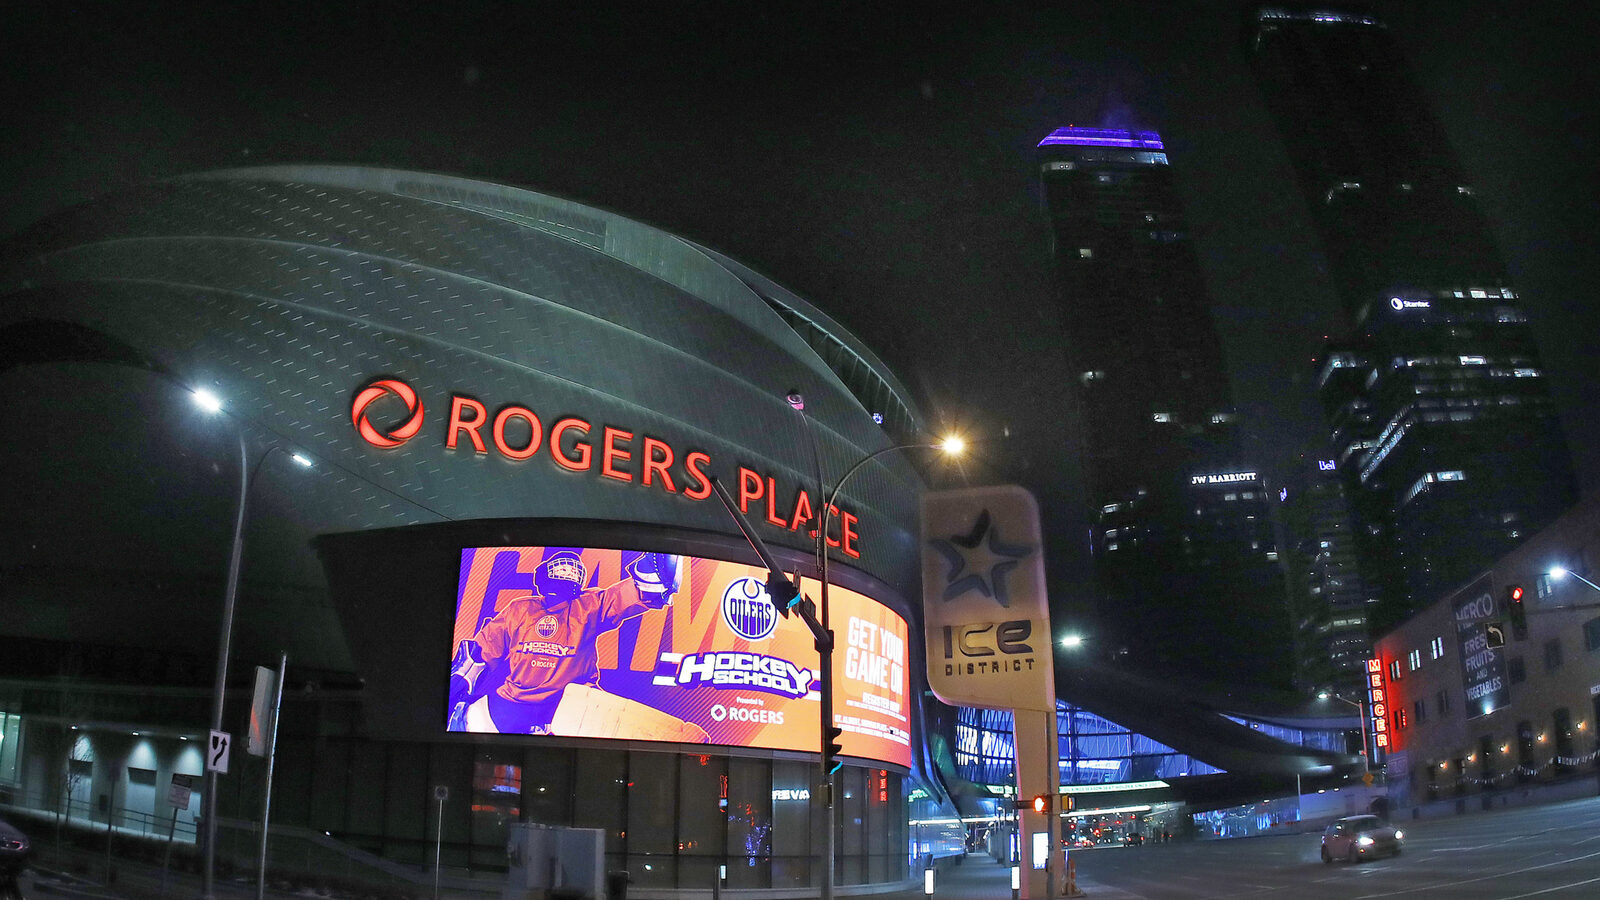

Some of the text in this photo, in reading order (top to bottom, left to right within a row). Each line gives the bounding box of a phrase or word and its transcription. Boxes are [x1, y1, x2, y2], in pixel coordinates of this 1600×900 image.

[445, 395, 860, 558] ROGERS PLACE
[1318, 460, 1336, 471] Bell
[1192, 472, 1257, 485] JW MARRIOTT
[730, 597, 771, 636] OILERS
[522, 641, 569, 657] HOCKEY
[847, 615, 904, 667] GET YOUR
[1464, 633, 1486, 654] FRES
[845, 647, 904, 695] GAME ON
[945, 658, 1034, 676] DISTRICT
[1465, 649, 1495, 672] FRUITS
[678, 653, 813, 696] HOCKEY
[712, 670, 799, 695] SCHOOL
[1476, 668, 1488, 680] AND
[1465, 676, 1502, 700] VEGETABLES
[1368, 658, 1388, 747] MERCER
[729, 707, 784, 725] ROGERS
